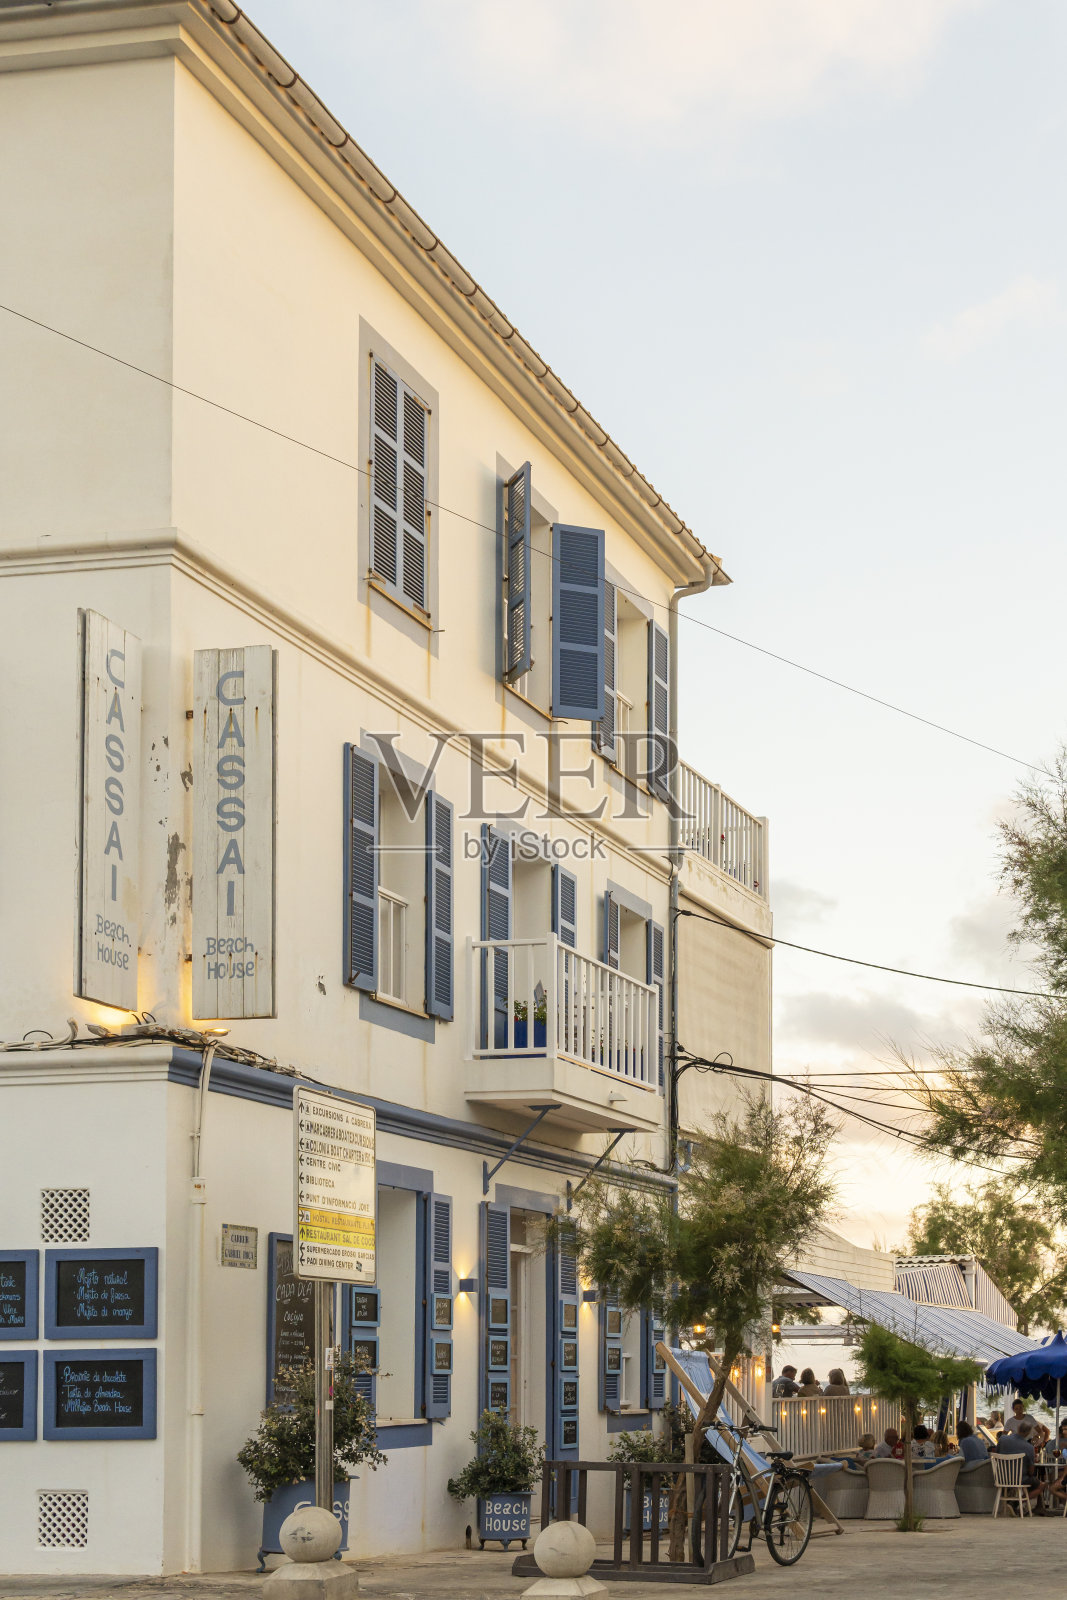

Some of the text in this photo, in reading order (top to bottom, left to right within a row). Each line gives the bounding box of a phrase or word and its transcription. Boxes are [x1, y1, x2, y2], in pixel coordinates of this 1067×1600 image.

[104, 648, 125, 902] CASSAI
[215, 670, 246, 917] CASSAI
[205, 936, 254, 956] Beach
[312, 1106, 343, 1122] EXCURSIONS
[351, 1117, 372, 1130] CABRERA
[305, 1156, 326, 1169] CENTRE
[305, 1175, 335, 1189] BIBLIOTECA
[305, 1193, 320, 1204] PUNT
[305, 1228, 341, 1244] RESTAURANT
[306, 1245, 341, 1257] SUPERMERCADO
[335, 1260, 354, 1270] CENTER
[484, 1500, 528, 1515] Beach
